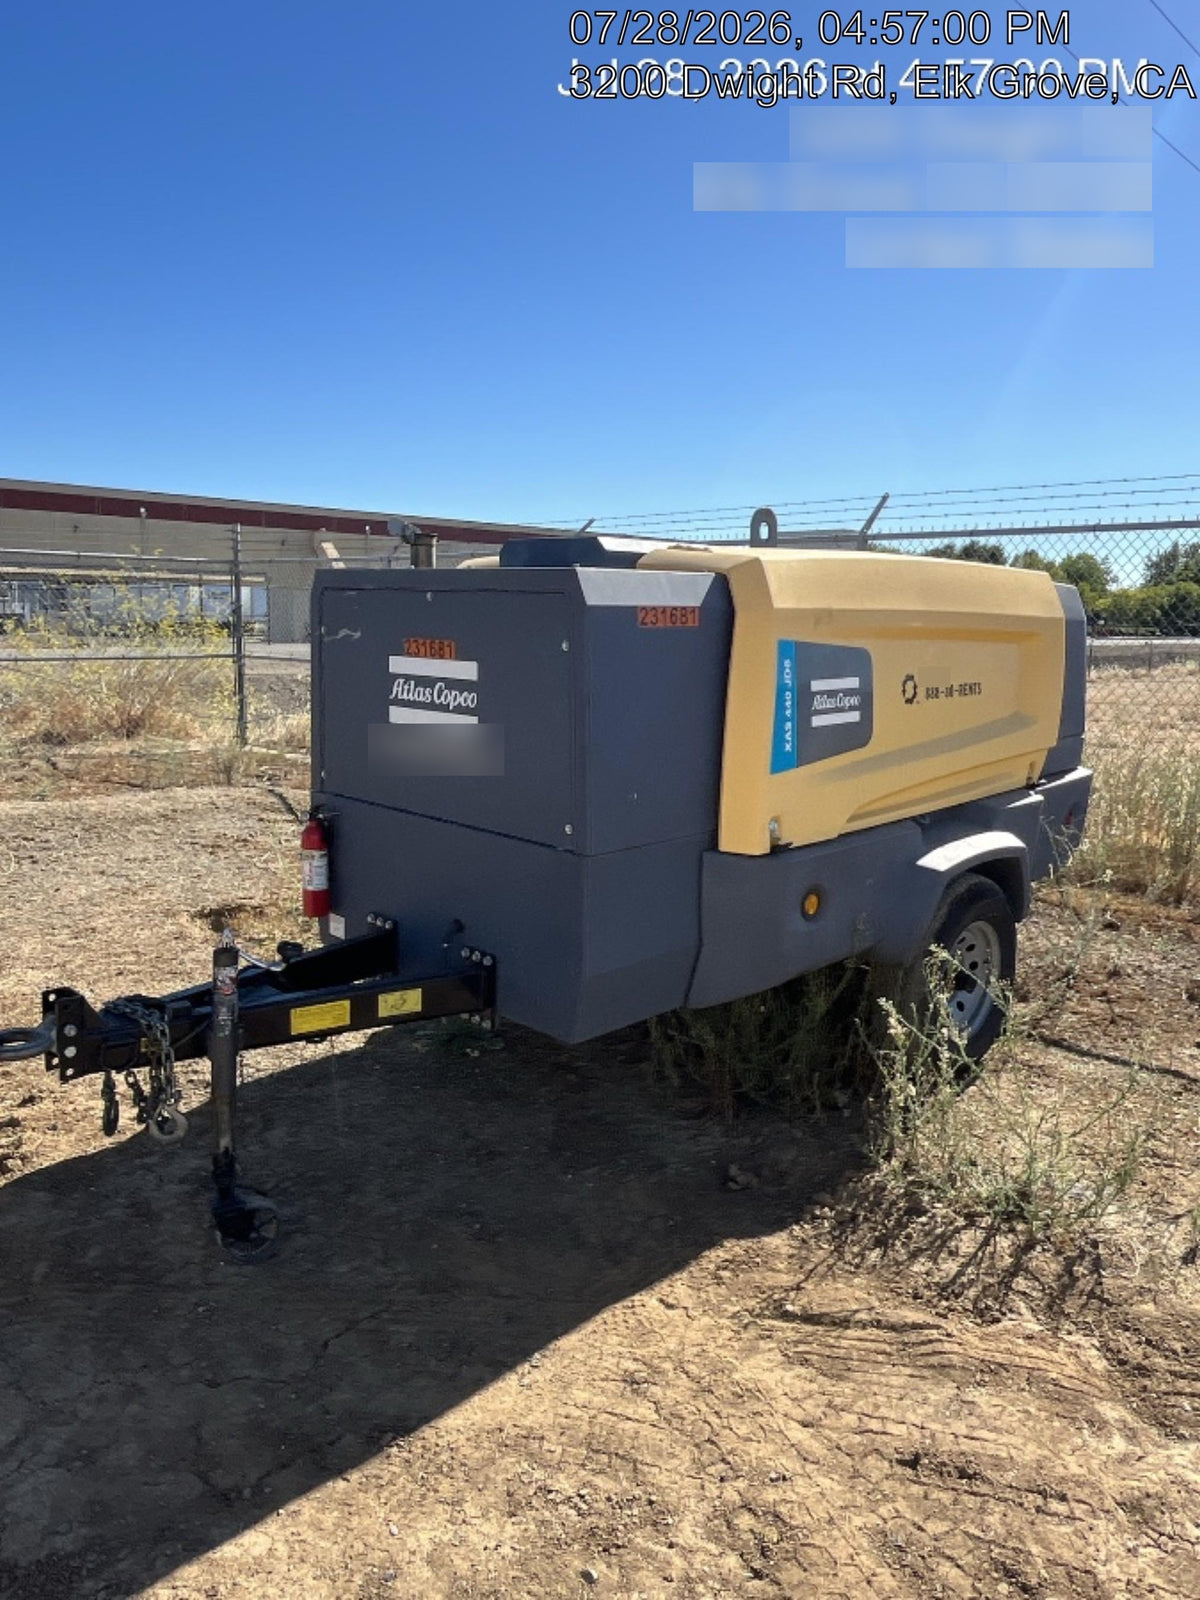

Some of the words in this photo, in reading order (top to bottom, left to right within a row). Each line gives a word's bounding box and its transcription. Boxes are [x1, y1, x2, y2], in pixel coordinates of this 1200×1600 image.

[640, 606, 697, 627] 231681
[389, 678, 433, 703] Atlas
[433, 682, 478, 711] Copco
